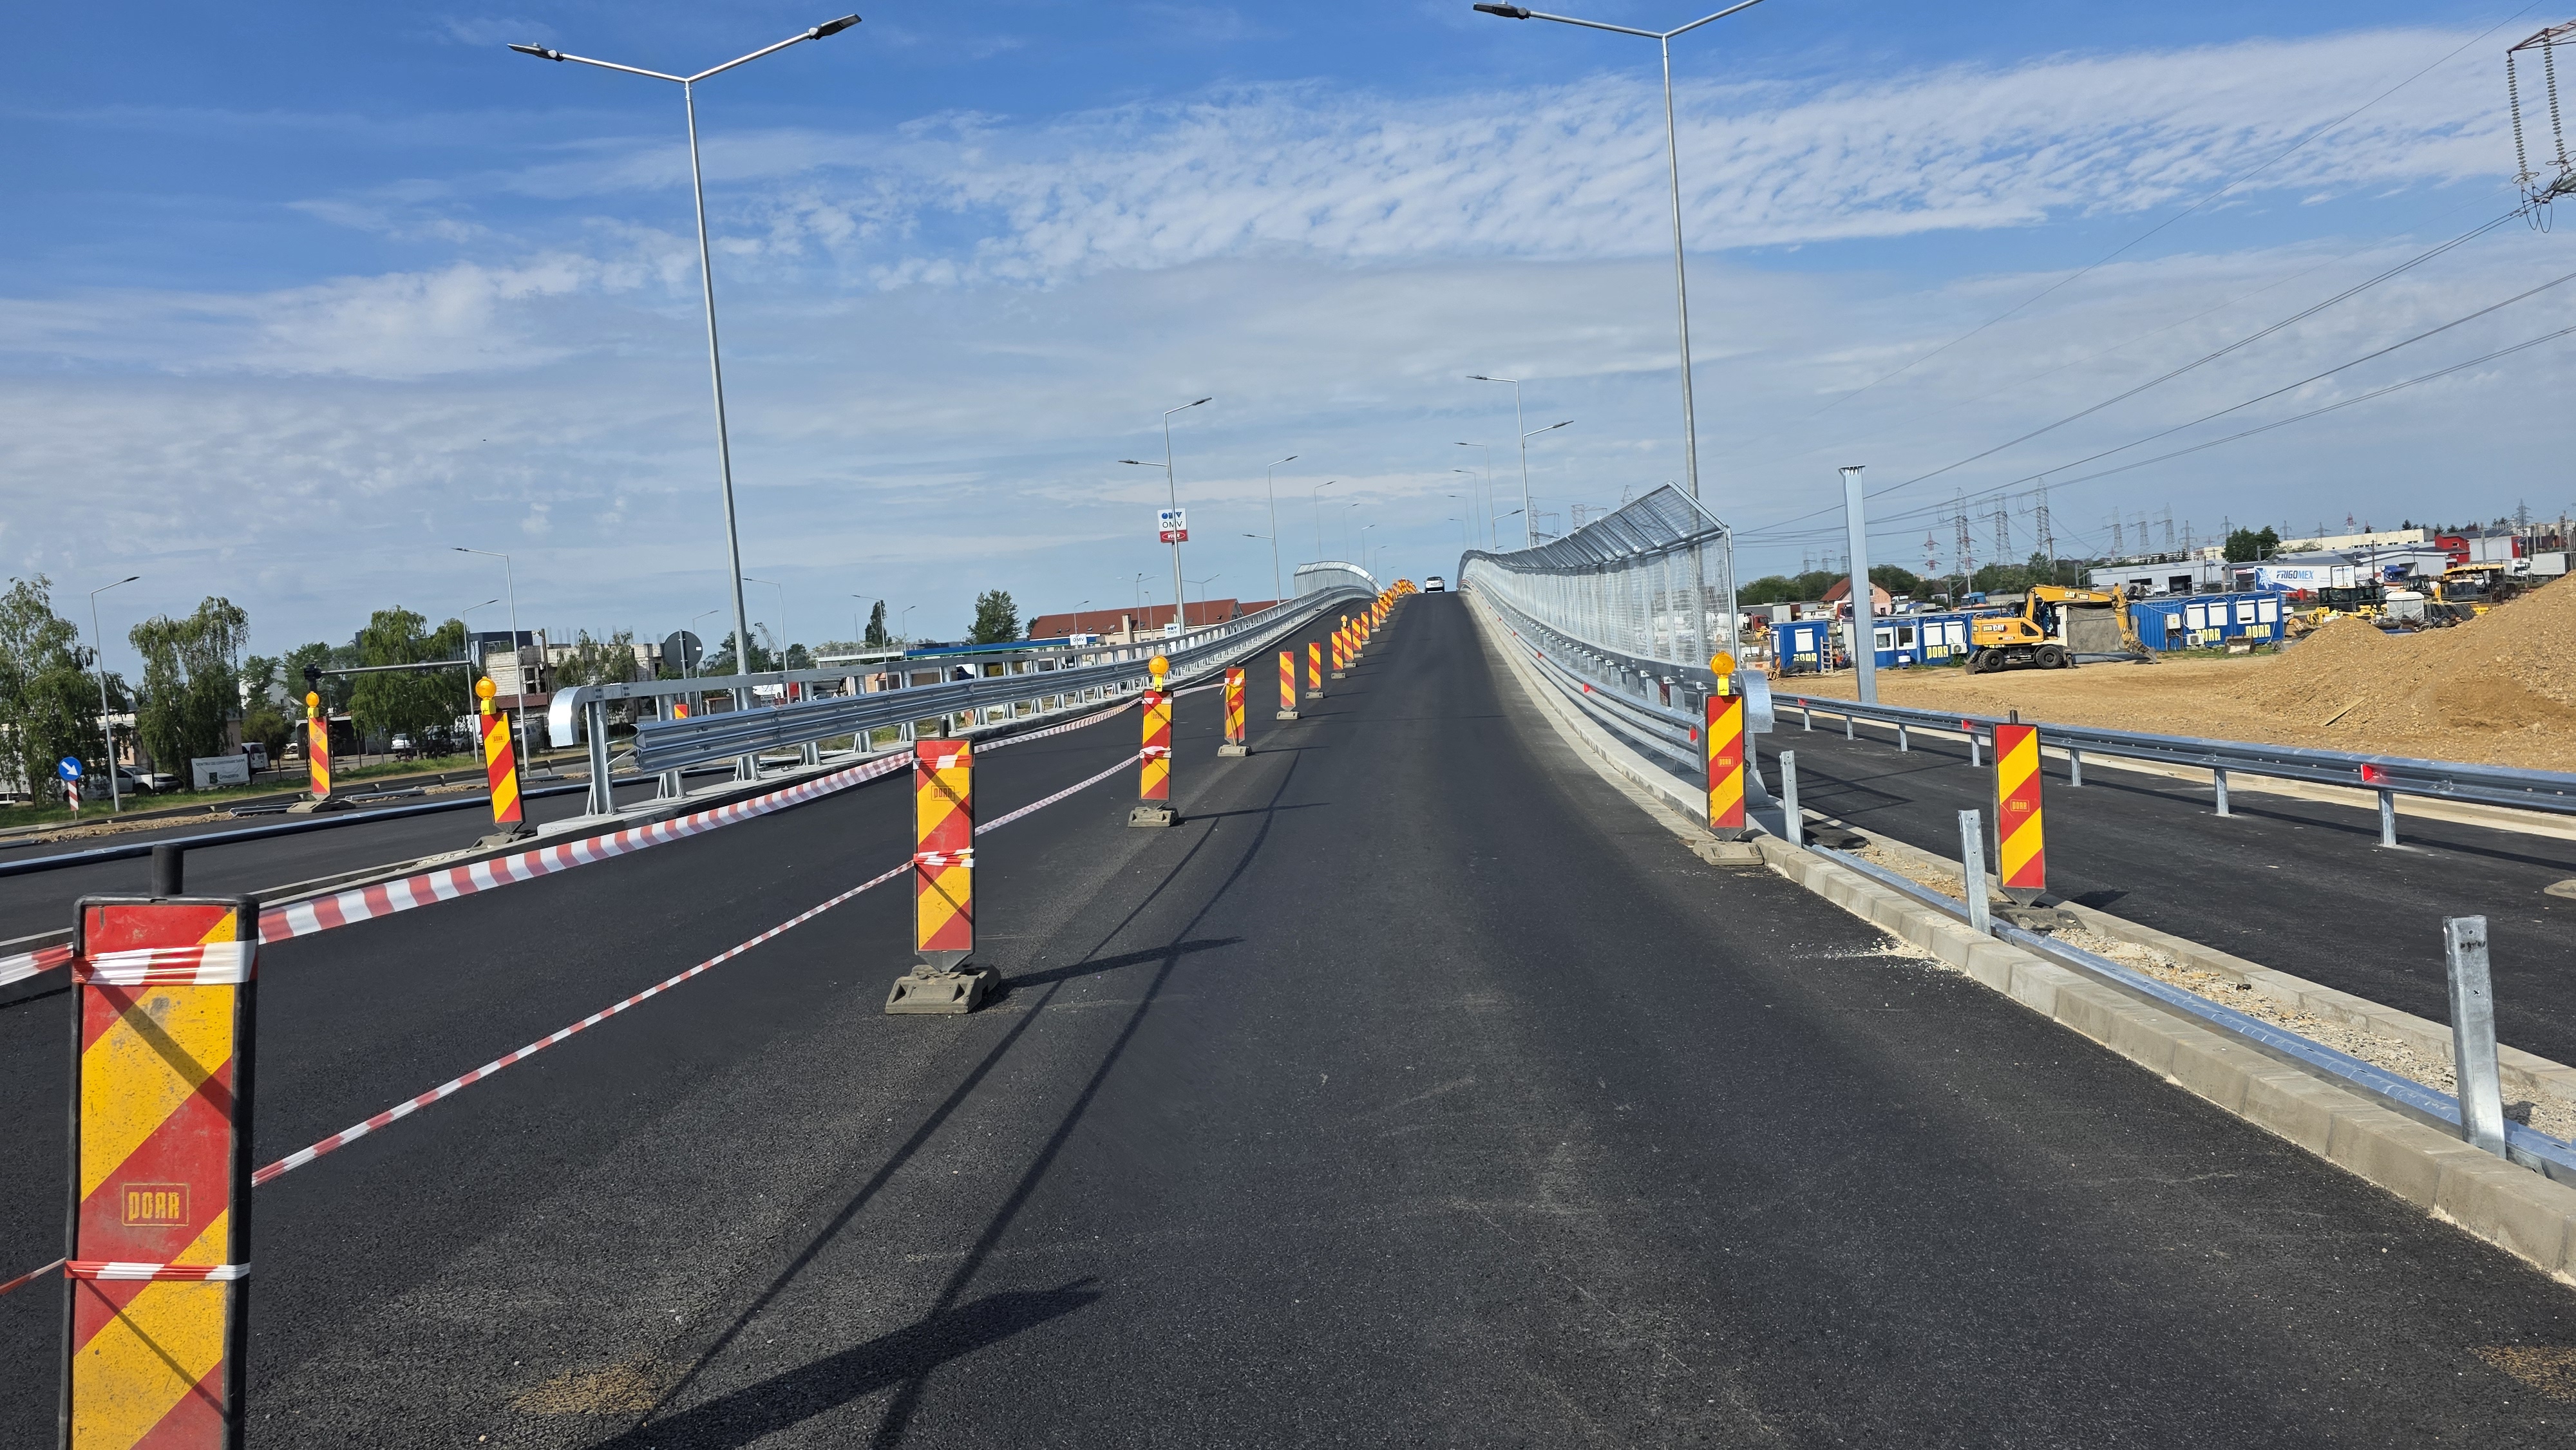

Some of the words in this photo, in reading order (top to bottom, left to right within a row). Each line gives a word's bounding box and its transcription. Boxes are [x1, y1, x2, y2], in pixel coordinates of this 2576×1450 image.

[2277, 570, 2315, 579] FRIGOMEX
[2246, 624, 2271, 638] PORR
[1926, 646, 1949, 659] PORR
[934, 787, 952, 798] PORR
[2012, 801, 2027, 811] PORR
[128, 1192, 180, 1221] PORR
